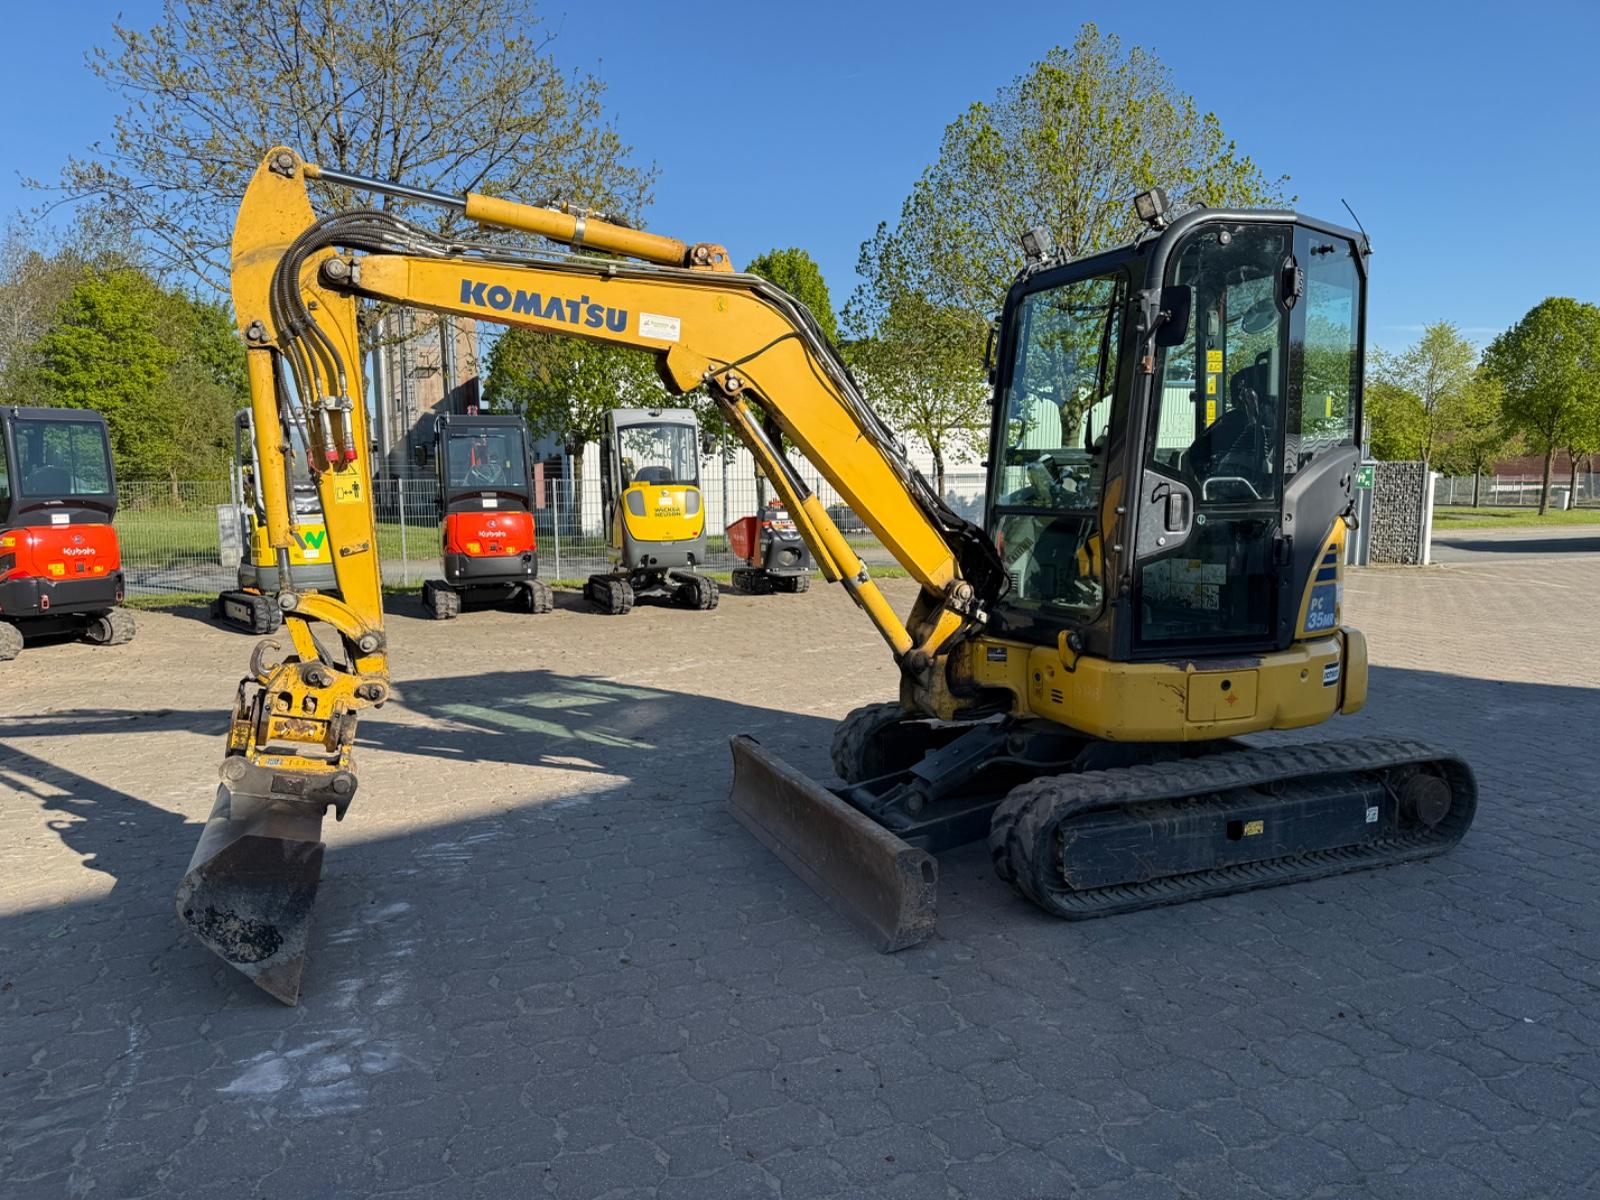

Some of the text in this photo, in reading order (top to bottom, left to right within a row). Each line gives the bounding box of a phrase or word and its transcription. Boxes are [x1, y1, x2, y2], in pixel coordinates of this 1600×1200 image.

[460, 279, 628, 333] KOMATSU
[478, 530, 507, 538] Kubota
[63, 547, 96, 556] Kubota
[1311, 597, 1324, 610] PC
